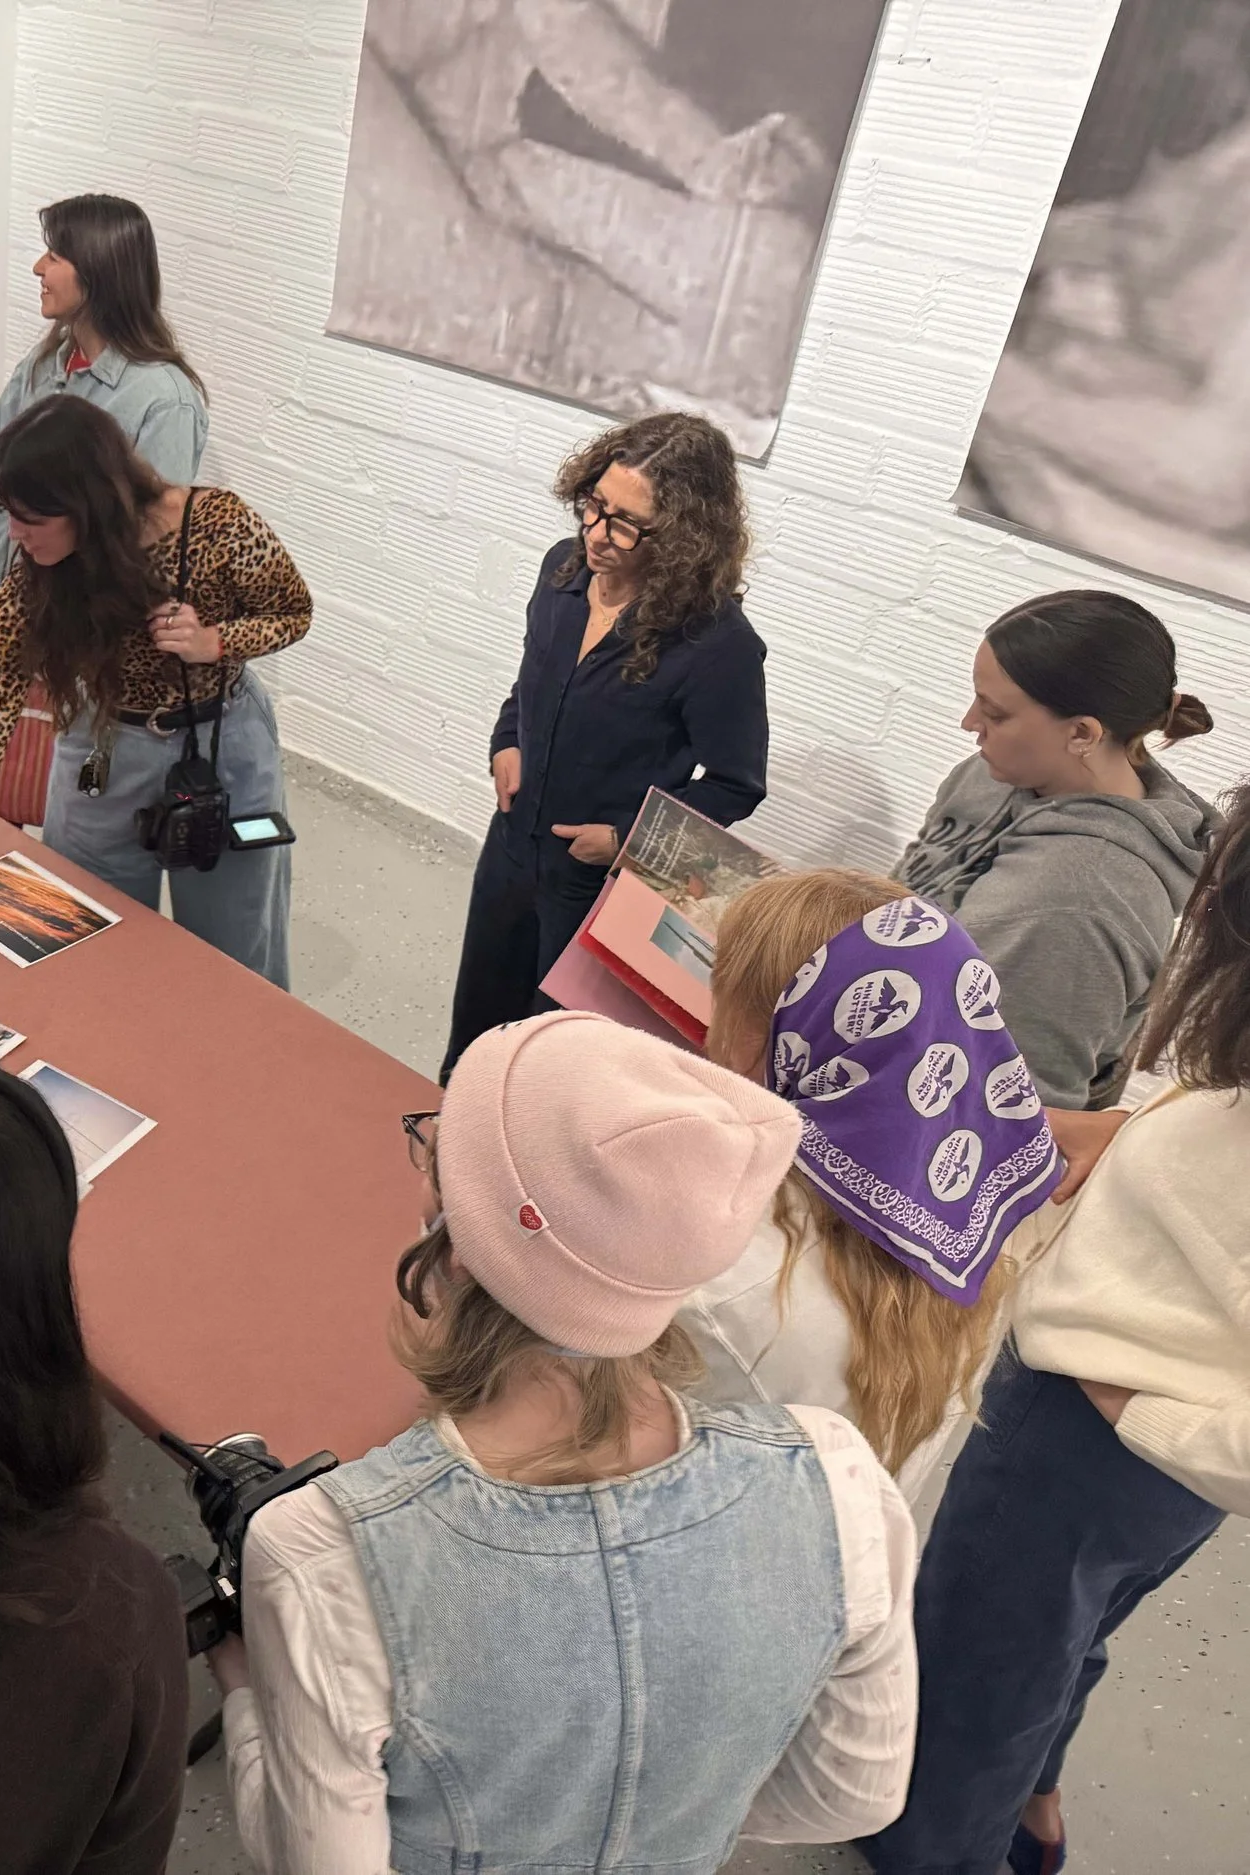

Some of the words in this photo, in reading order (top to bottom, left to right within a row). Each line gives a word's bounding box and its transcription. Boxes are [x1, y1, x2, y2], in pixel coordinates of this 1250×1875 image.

[846, 987, 863, 1033] LOTTERY
[854, 982, 874, 1037] MINNESOTA
[990, 1064, 1022, 1095] OTTERY
[934, 1138, 956, 1180] LOTTERY
[938, 1137, 962, 1186] MINNESOTA
